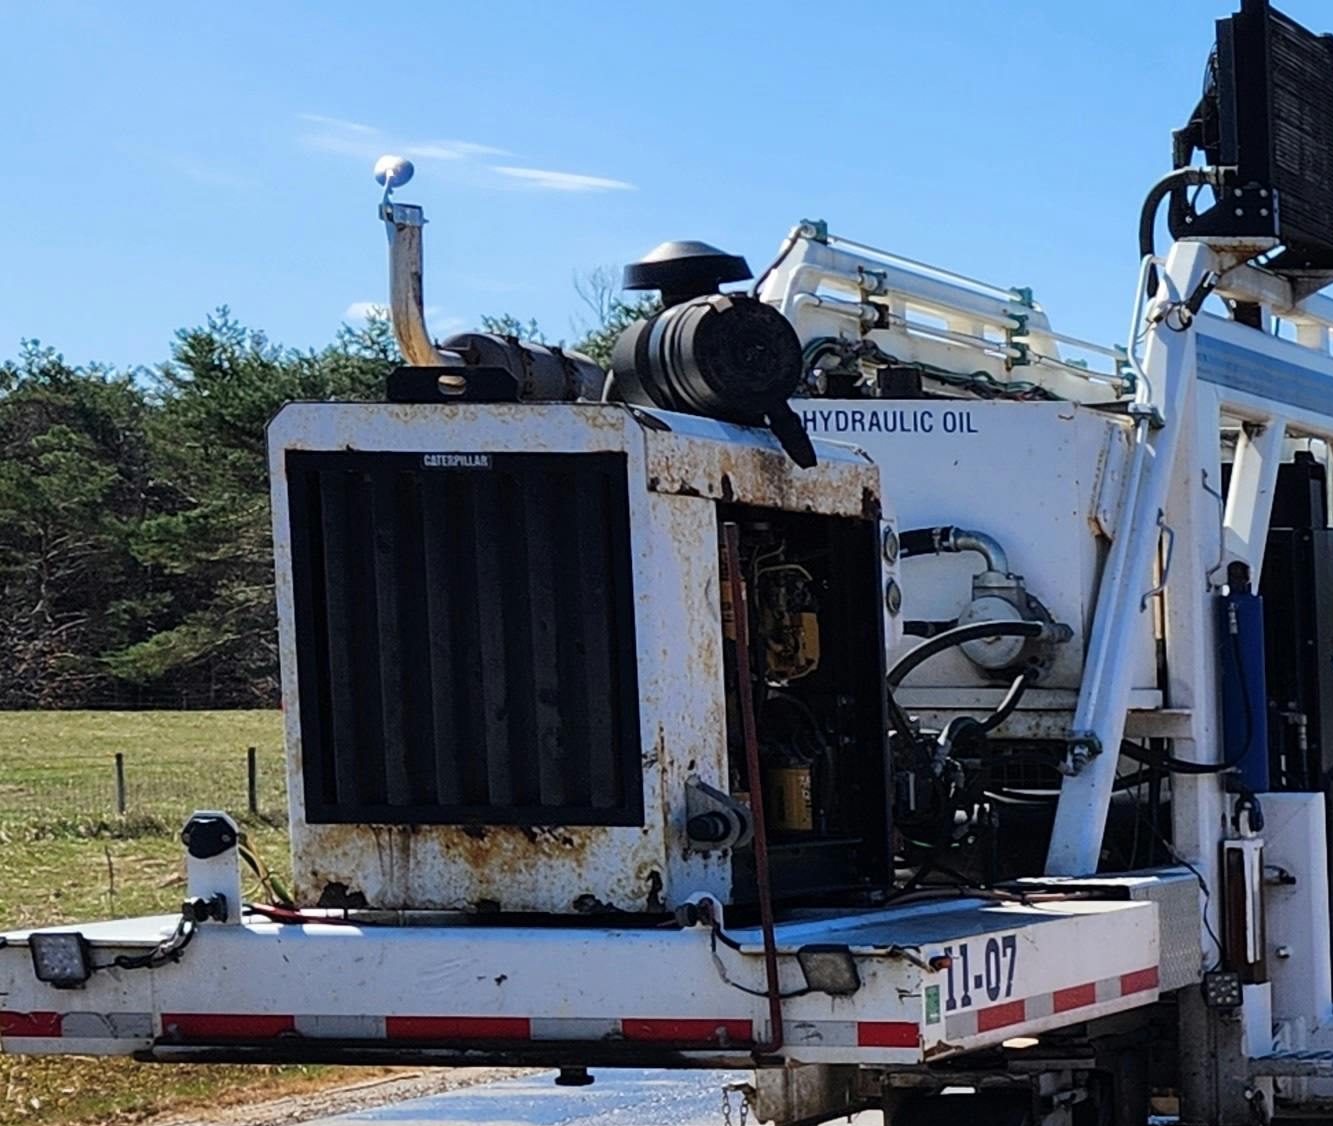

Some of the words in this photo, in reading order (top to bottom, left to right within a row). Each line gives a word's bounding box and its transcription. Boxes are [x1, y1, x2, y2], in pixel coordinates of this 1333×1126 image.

[803, 410, 934, 433] HYDRAULIC
[943, 411, 979, 433] OIL
[423, 454, 489, 467] CATERPILLAR
[944, 934, 1017, 1011] 11-07
